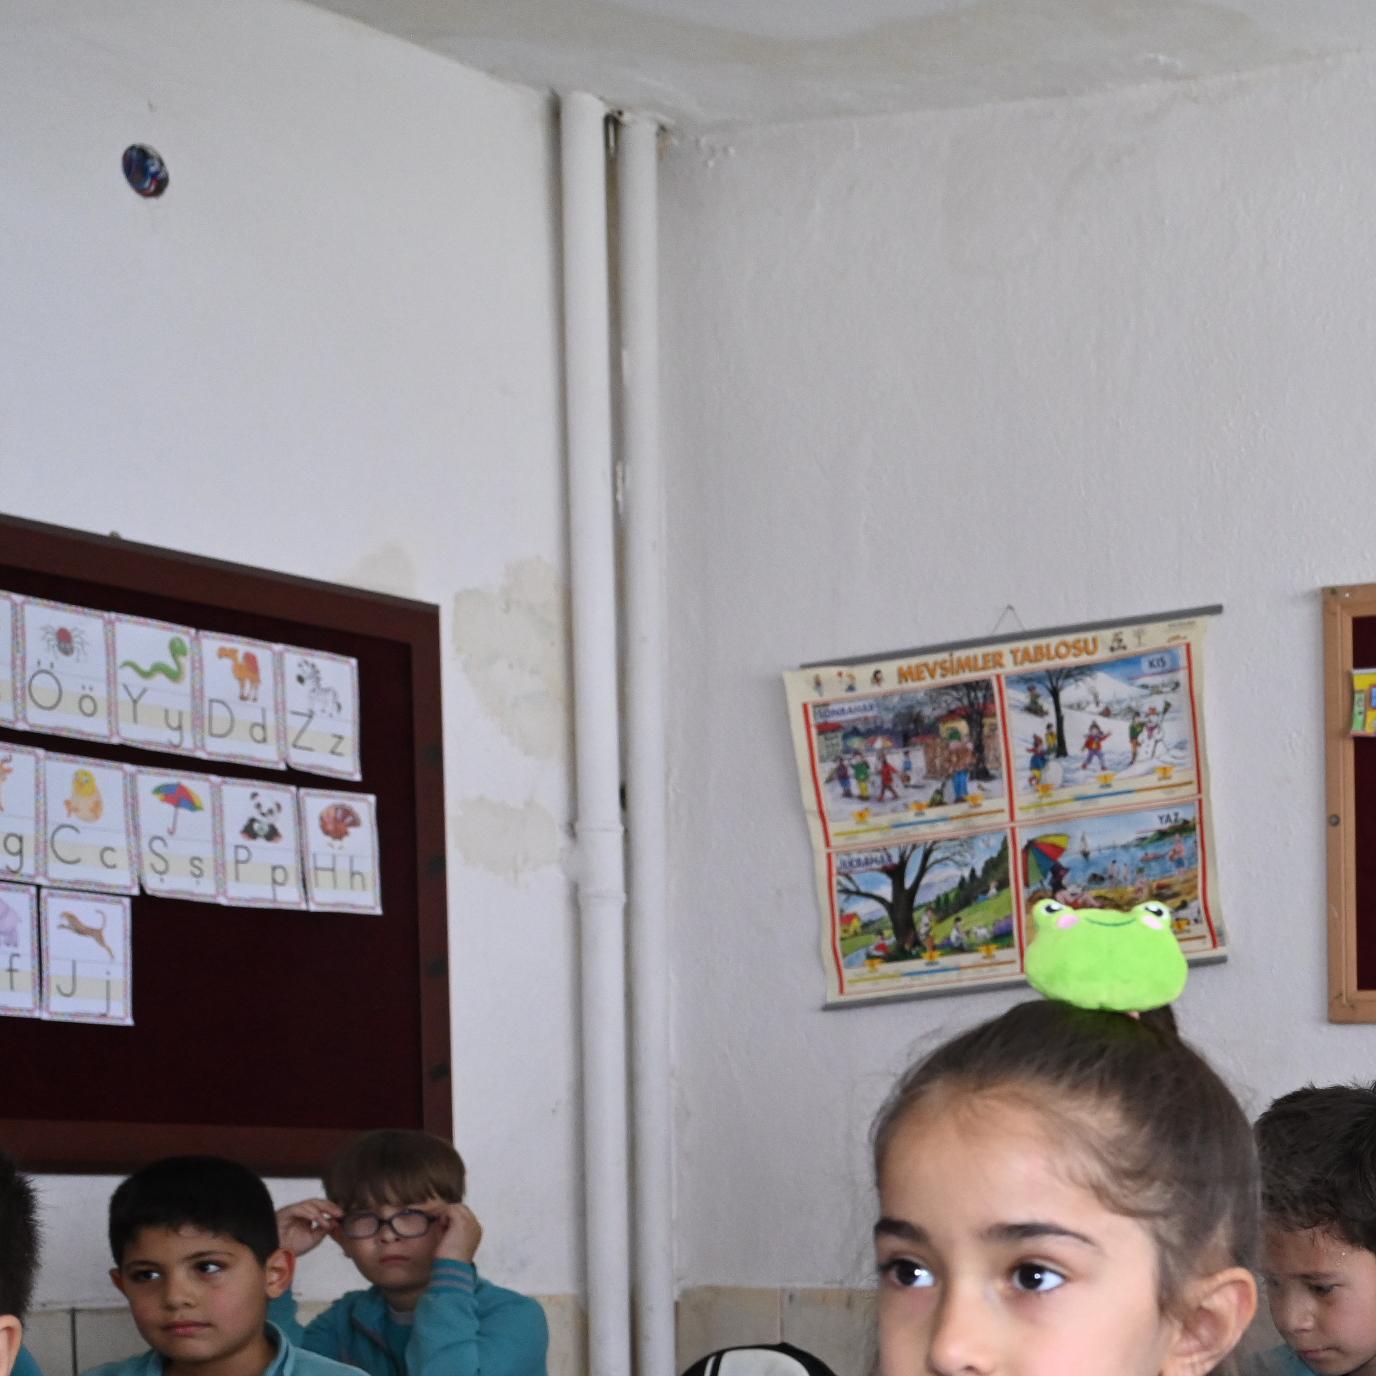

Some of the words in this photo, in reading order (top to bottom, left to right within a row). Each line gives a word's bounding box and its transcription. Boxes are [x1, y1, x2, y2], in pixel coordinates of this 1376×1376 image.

[898, 650, 1005, 684] MEVSİMLER
[1010, 637, 1099, 666] TABLOSU
[28, 660, 63, 711] Ö
[79, 684, 98, 718] ö
[123, 683, 148, 723] Y
[164, 708, 184, 748] y
[208, 699, 235, 738] D
[249, 707, 269, 744] d
[290, 710, 316, 752] Z
[330, 734, 346, 757] z
[50, 823, 82, 866] C
[100, 846, 118, 870] c
[148, 835, 170, 884] Ş
[234, 844, 252, 883] P
[270, 864, 289, 902] p
[312, 852, 338, 890] H
[349, 854, 367, 892] h
[5, 952, 21, 992] f
[56, 959, 77, 998] J
[101, 970, 111, 1017] j
